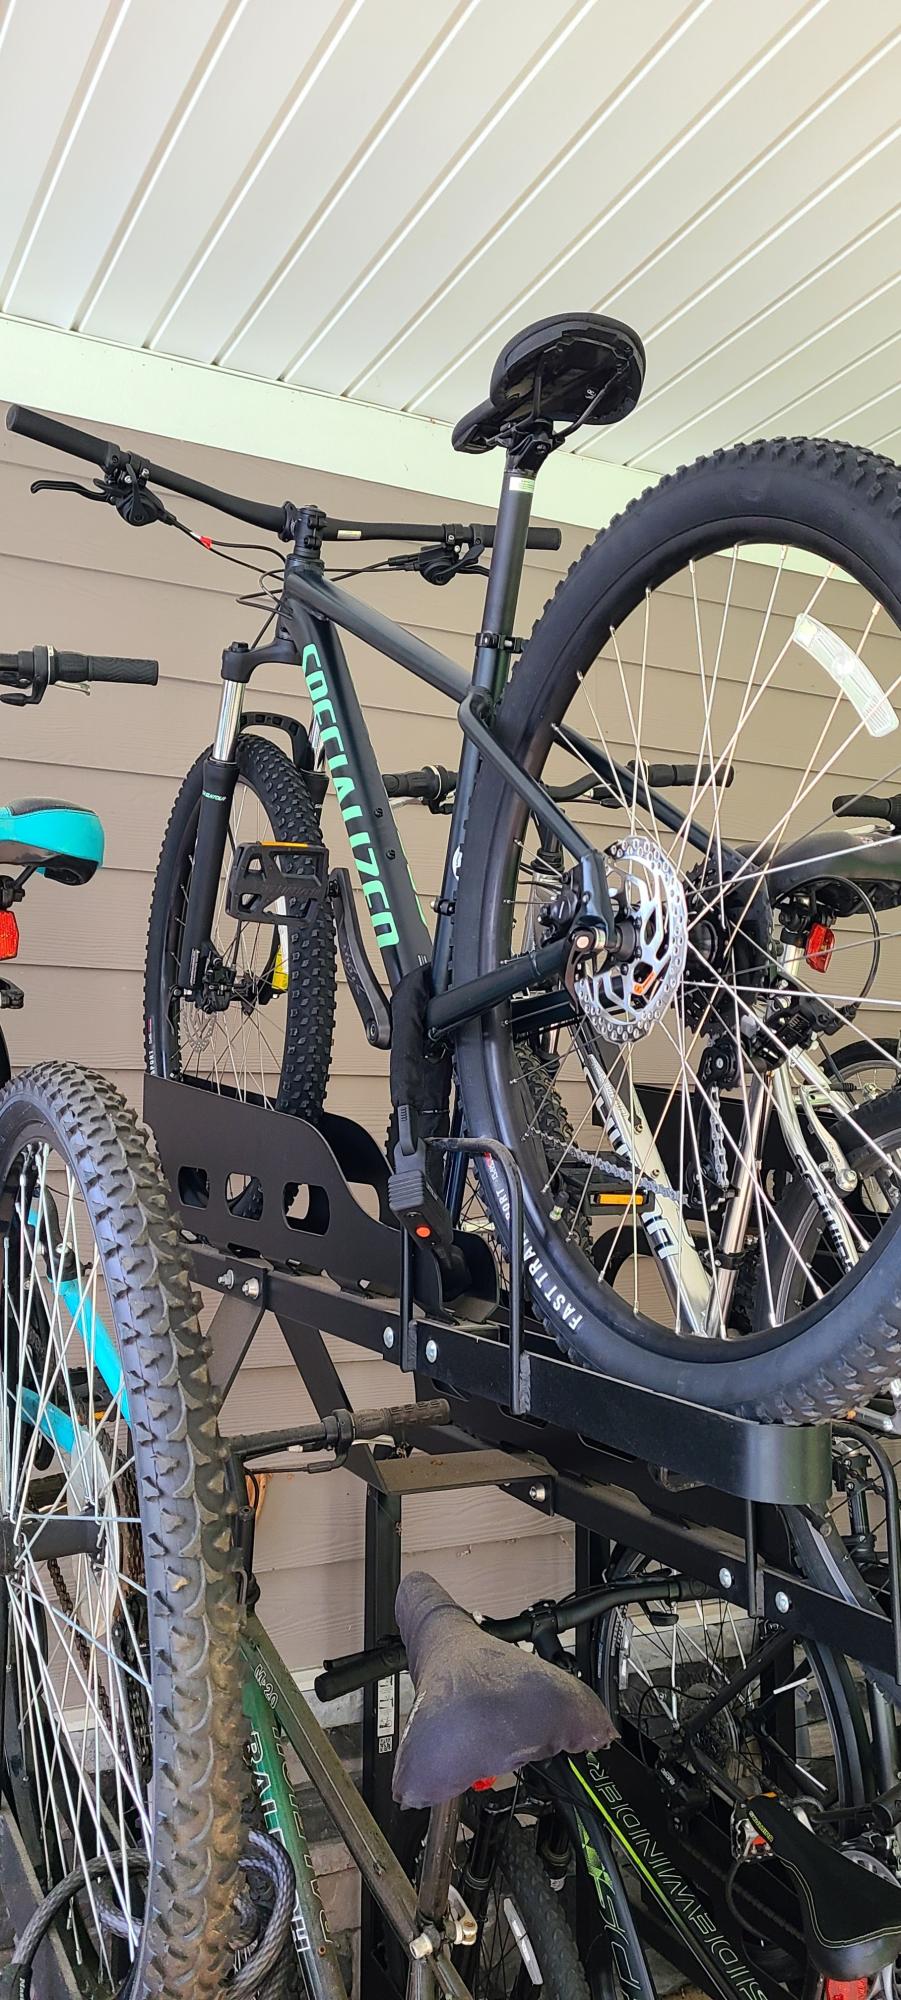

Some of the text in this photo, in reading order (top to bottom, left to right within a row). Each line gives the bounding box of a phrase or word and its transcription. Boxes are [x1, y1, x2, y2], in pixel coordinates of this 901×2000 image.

[544, 1285, 583, 1331] FAST
[254, 1663, 278, 1709] M-20
[588, 1767, 770, 2000] SIDEWINDER
